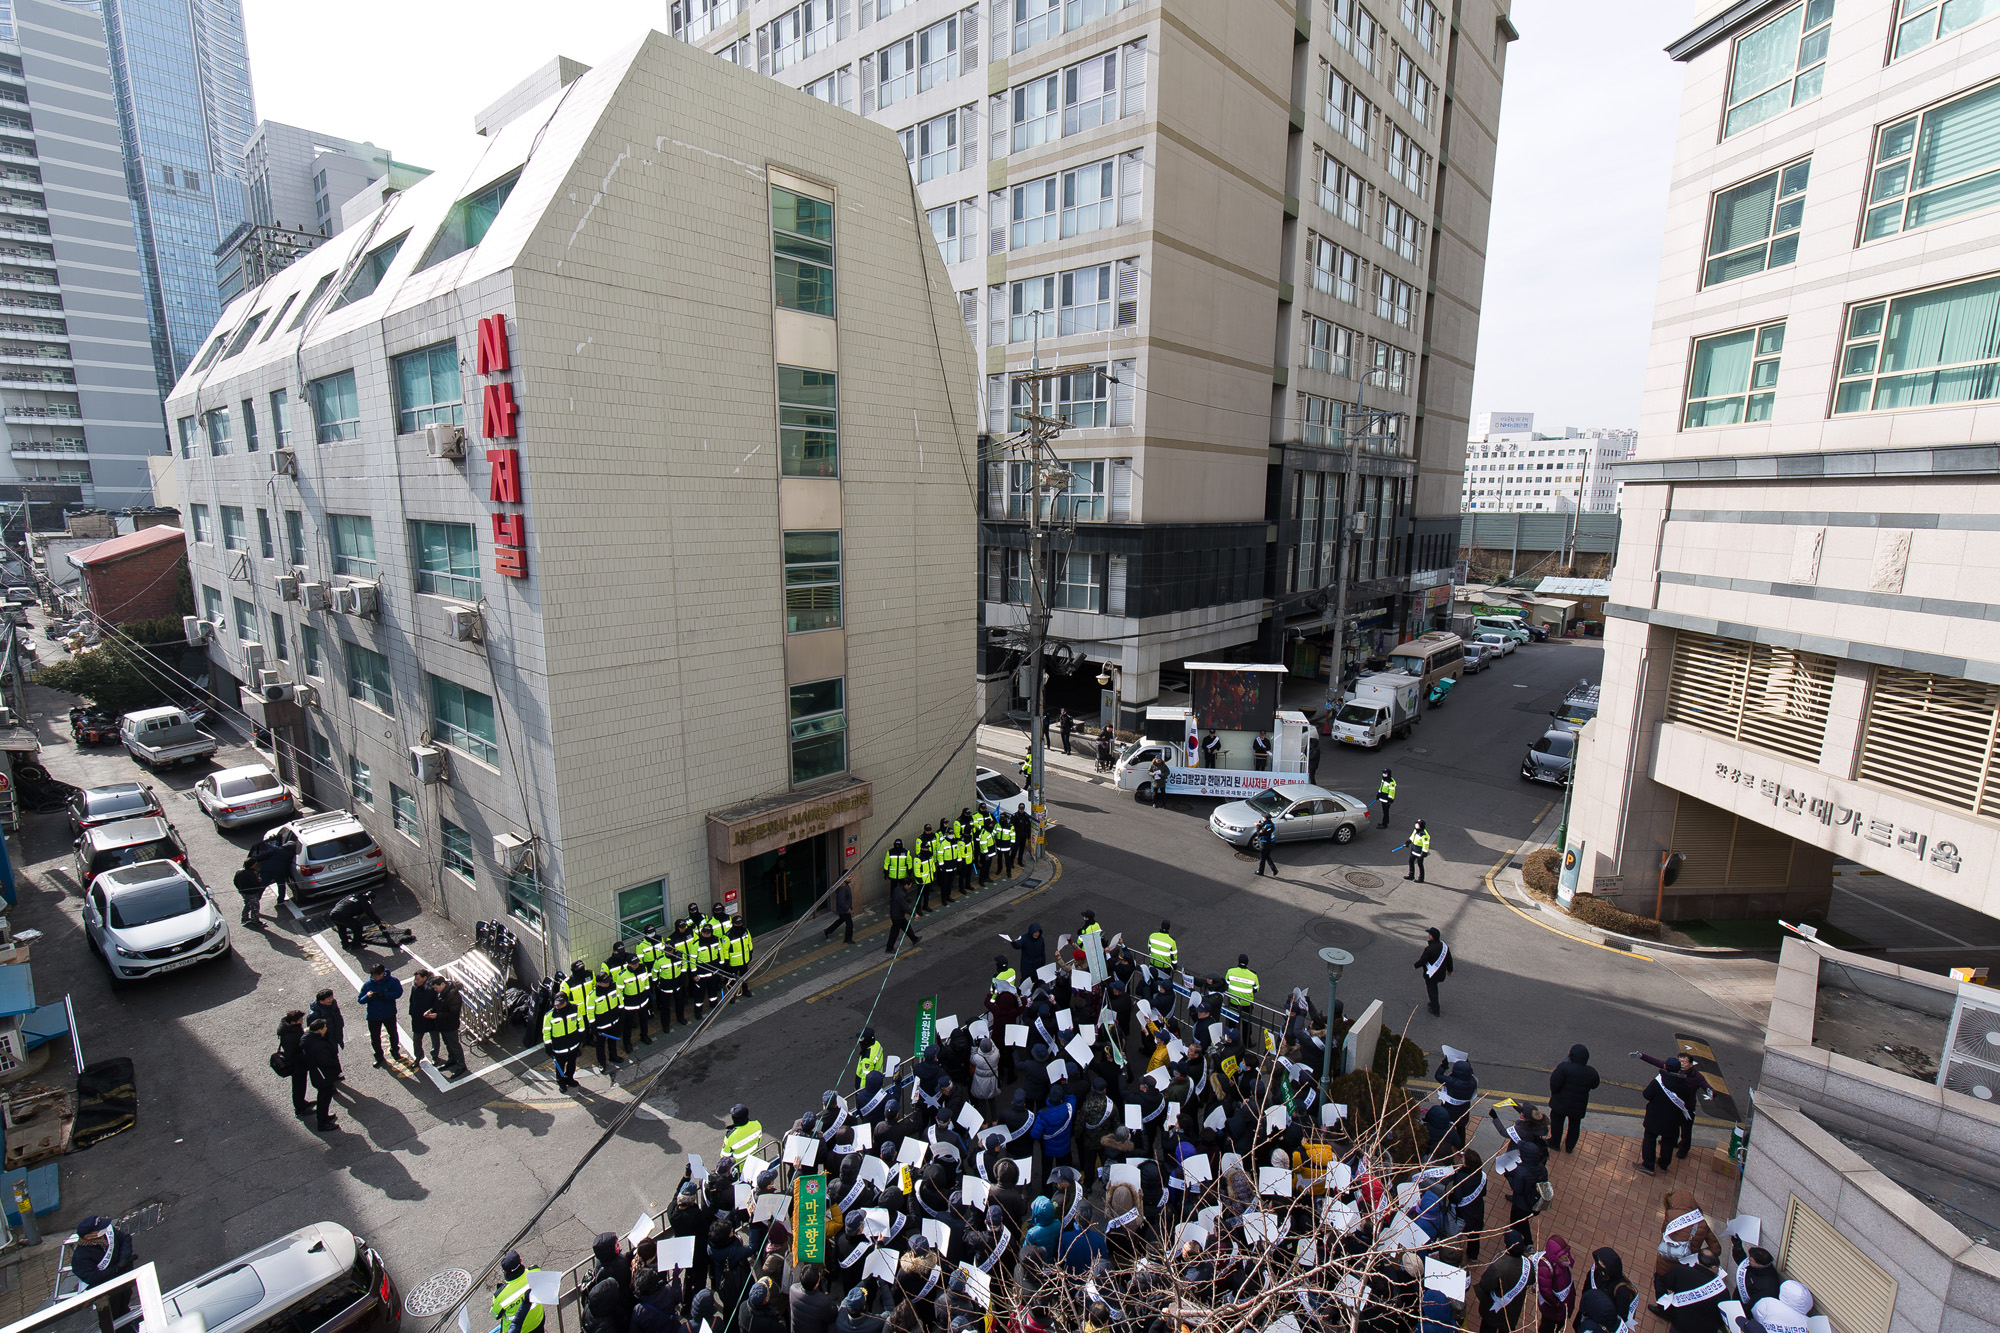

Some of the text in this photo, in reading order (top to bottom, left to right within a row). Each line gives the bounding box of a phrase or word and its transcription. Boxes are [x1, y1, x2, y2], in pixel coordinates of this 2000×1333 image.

[476, 313, 528, 578] 시사저널
[1241, 776, 1270, 789] 시사저널!
[1715, 762, 1963, 874] 한강로 벽산메가트리움
[1566, 854, 1575, 866] P
[804, 1198, 819, 1259] 마포향군
